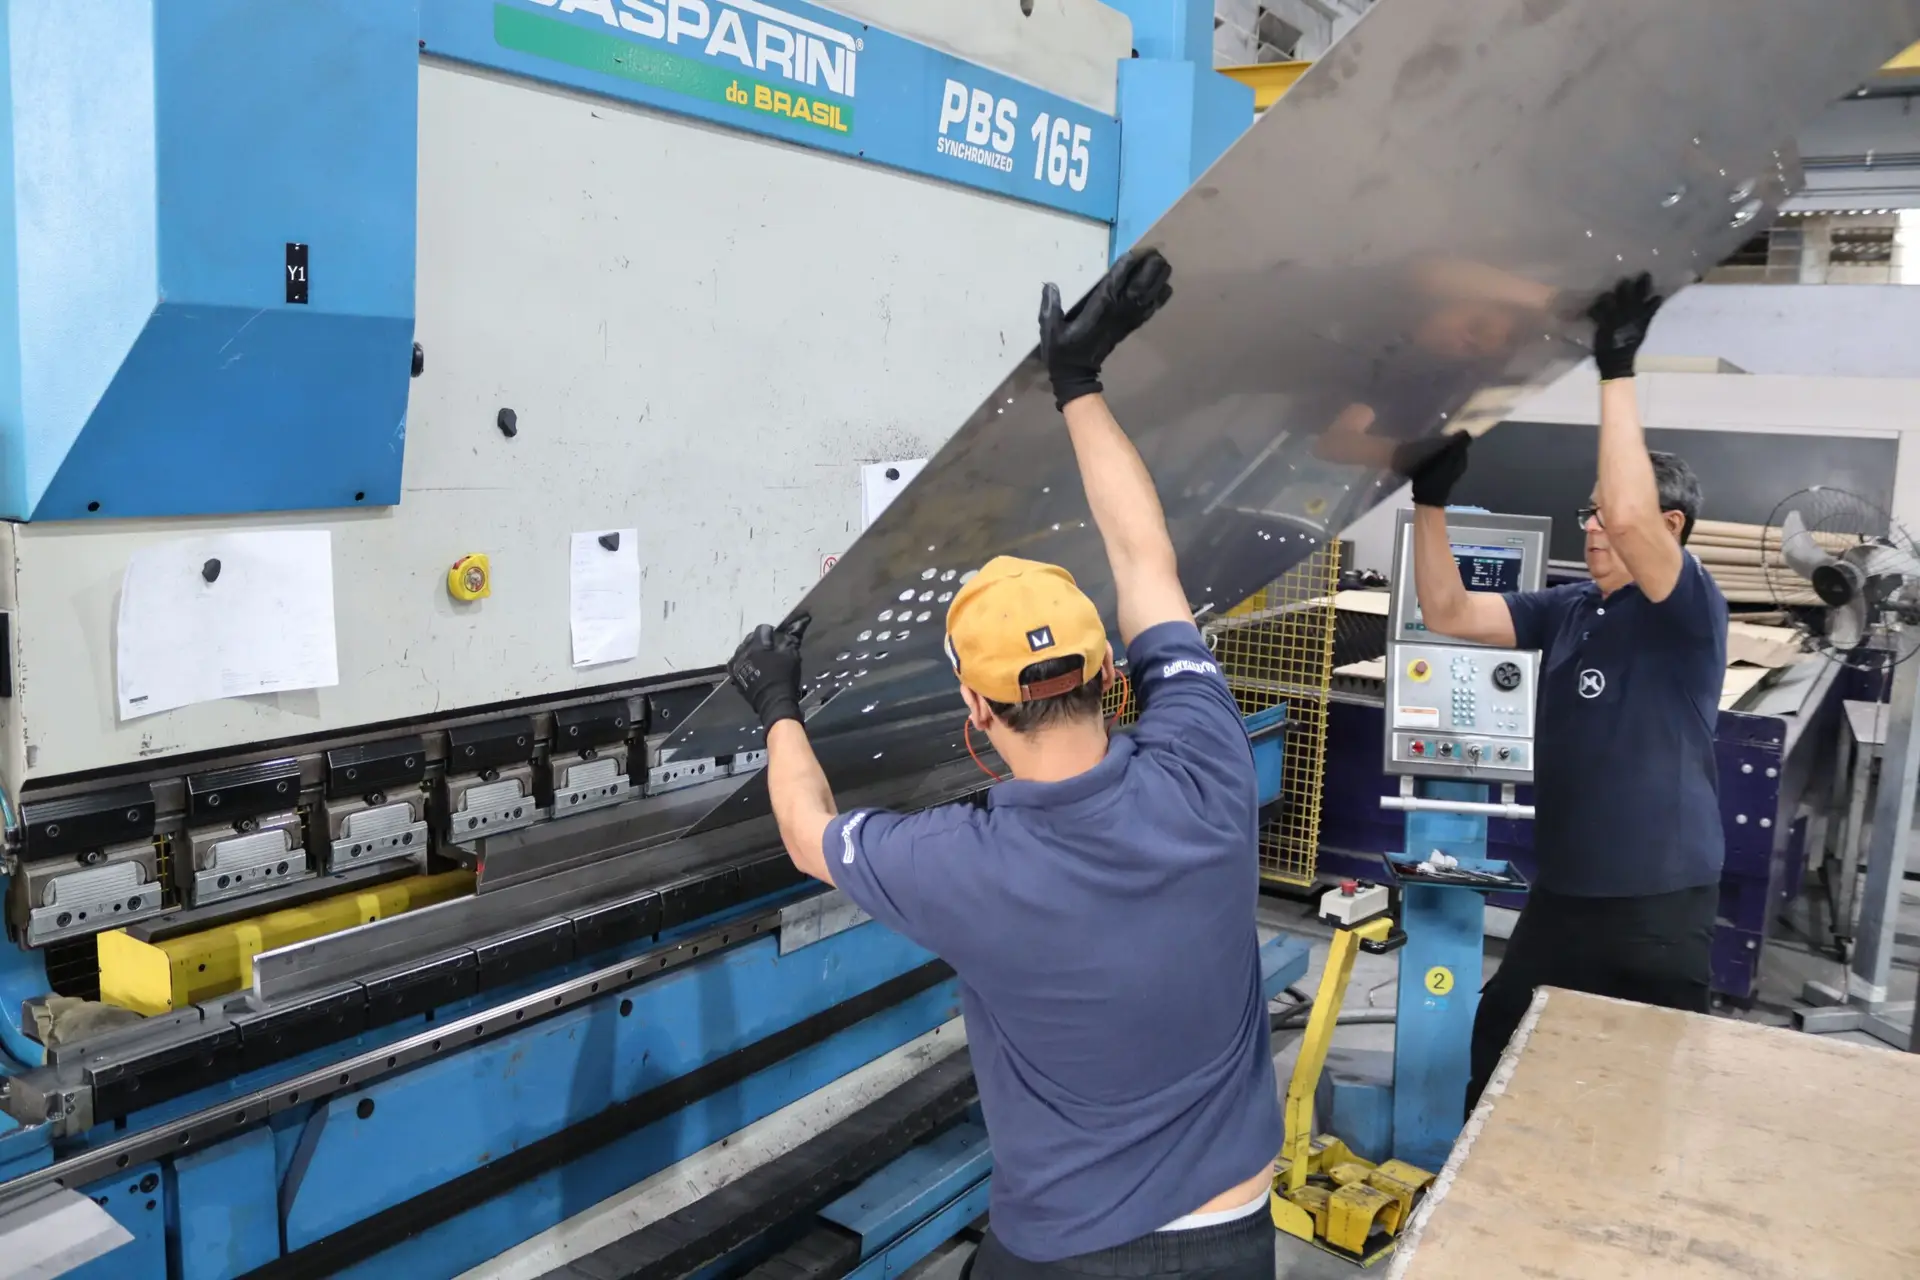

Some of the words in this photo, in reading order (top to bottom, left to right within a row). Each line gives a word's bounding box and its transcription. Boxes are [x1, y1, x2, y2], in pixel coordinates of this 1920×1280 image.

[527, 0, 856, 97] ASPARINI
[725, 79, 749, 105] do
[754, 84, 848, 132] BRASIL
[936, 136, 1014, 173] SYNCHRONIZED
[938, 78, 1018, 154] PBS
[1031, 112, 1092, 192] 165
[287, 265, 306, 282] Y1
[1433, 972, 1446, 990] 2
